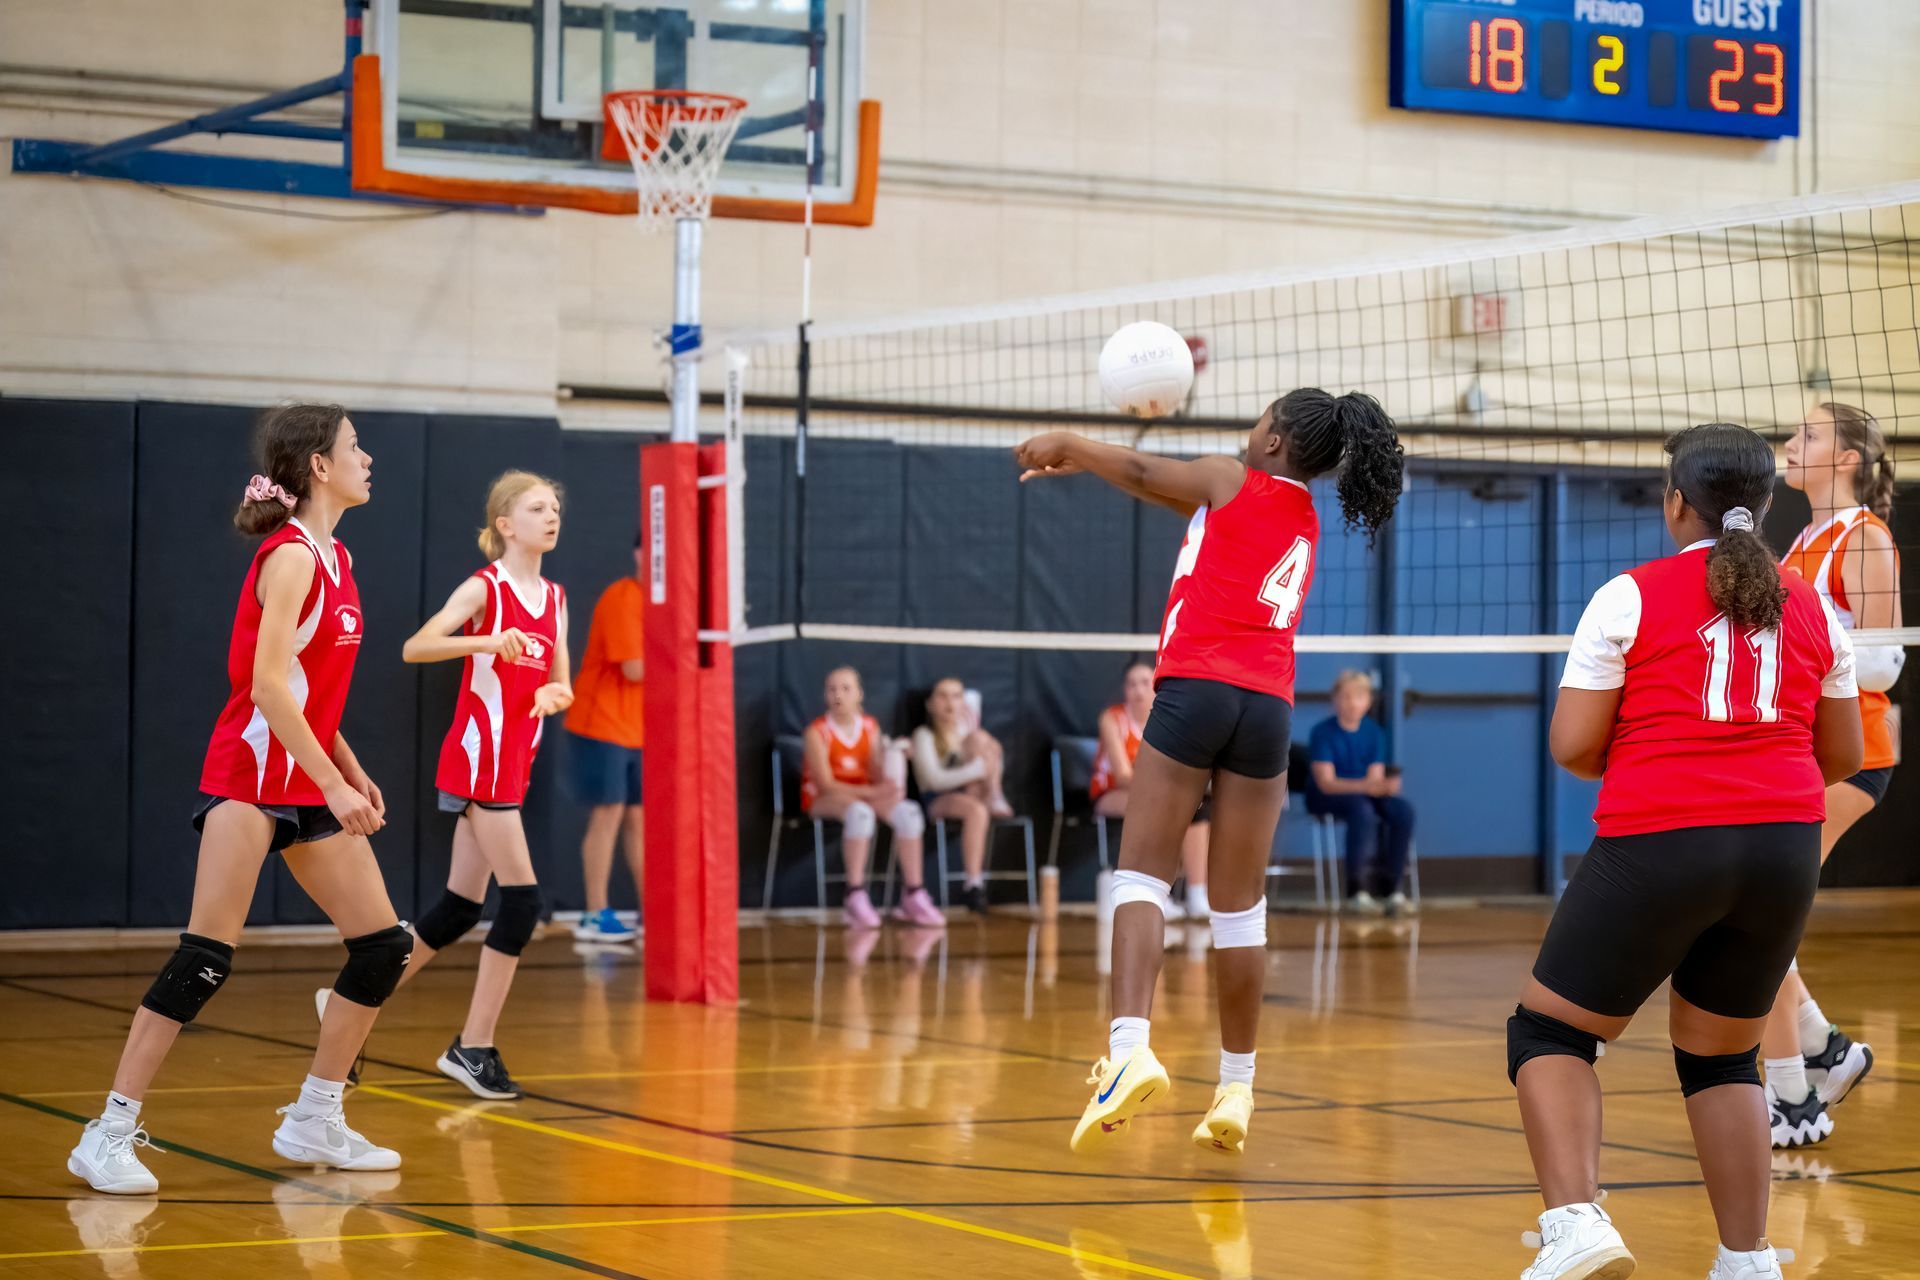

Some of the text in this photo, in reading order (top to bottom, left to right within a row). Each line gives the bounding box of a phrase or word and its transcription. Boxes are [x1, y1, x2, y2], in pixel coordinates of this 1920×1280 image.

[1574, 0, 1644, 28] PERIOD
[1693, 0, 1782, 32] GUEST
[1468, 17, 1524, 94] 18
[1592, 34, 1624, 95] 2
[1708, 39, 1784, 116] 23
[1256, 534, 1312, 630] 4
[1696, 609, 1783, 723] 11
